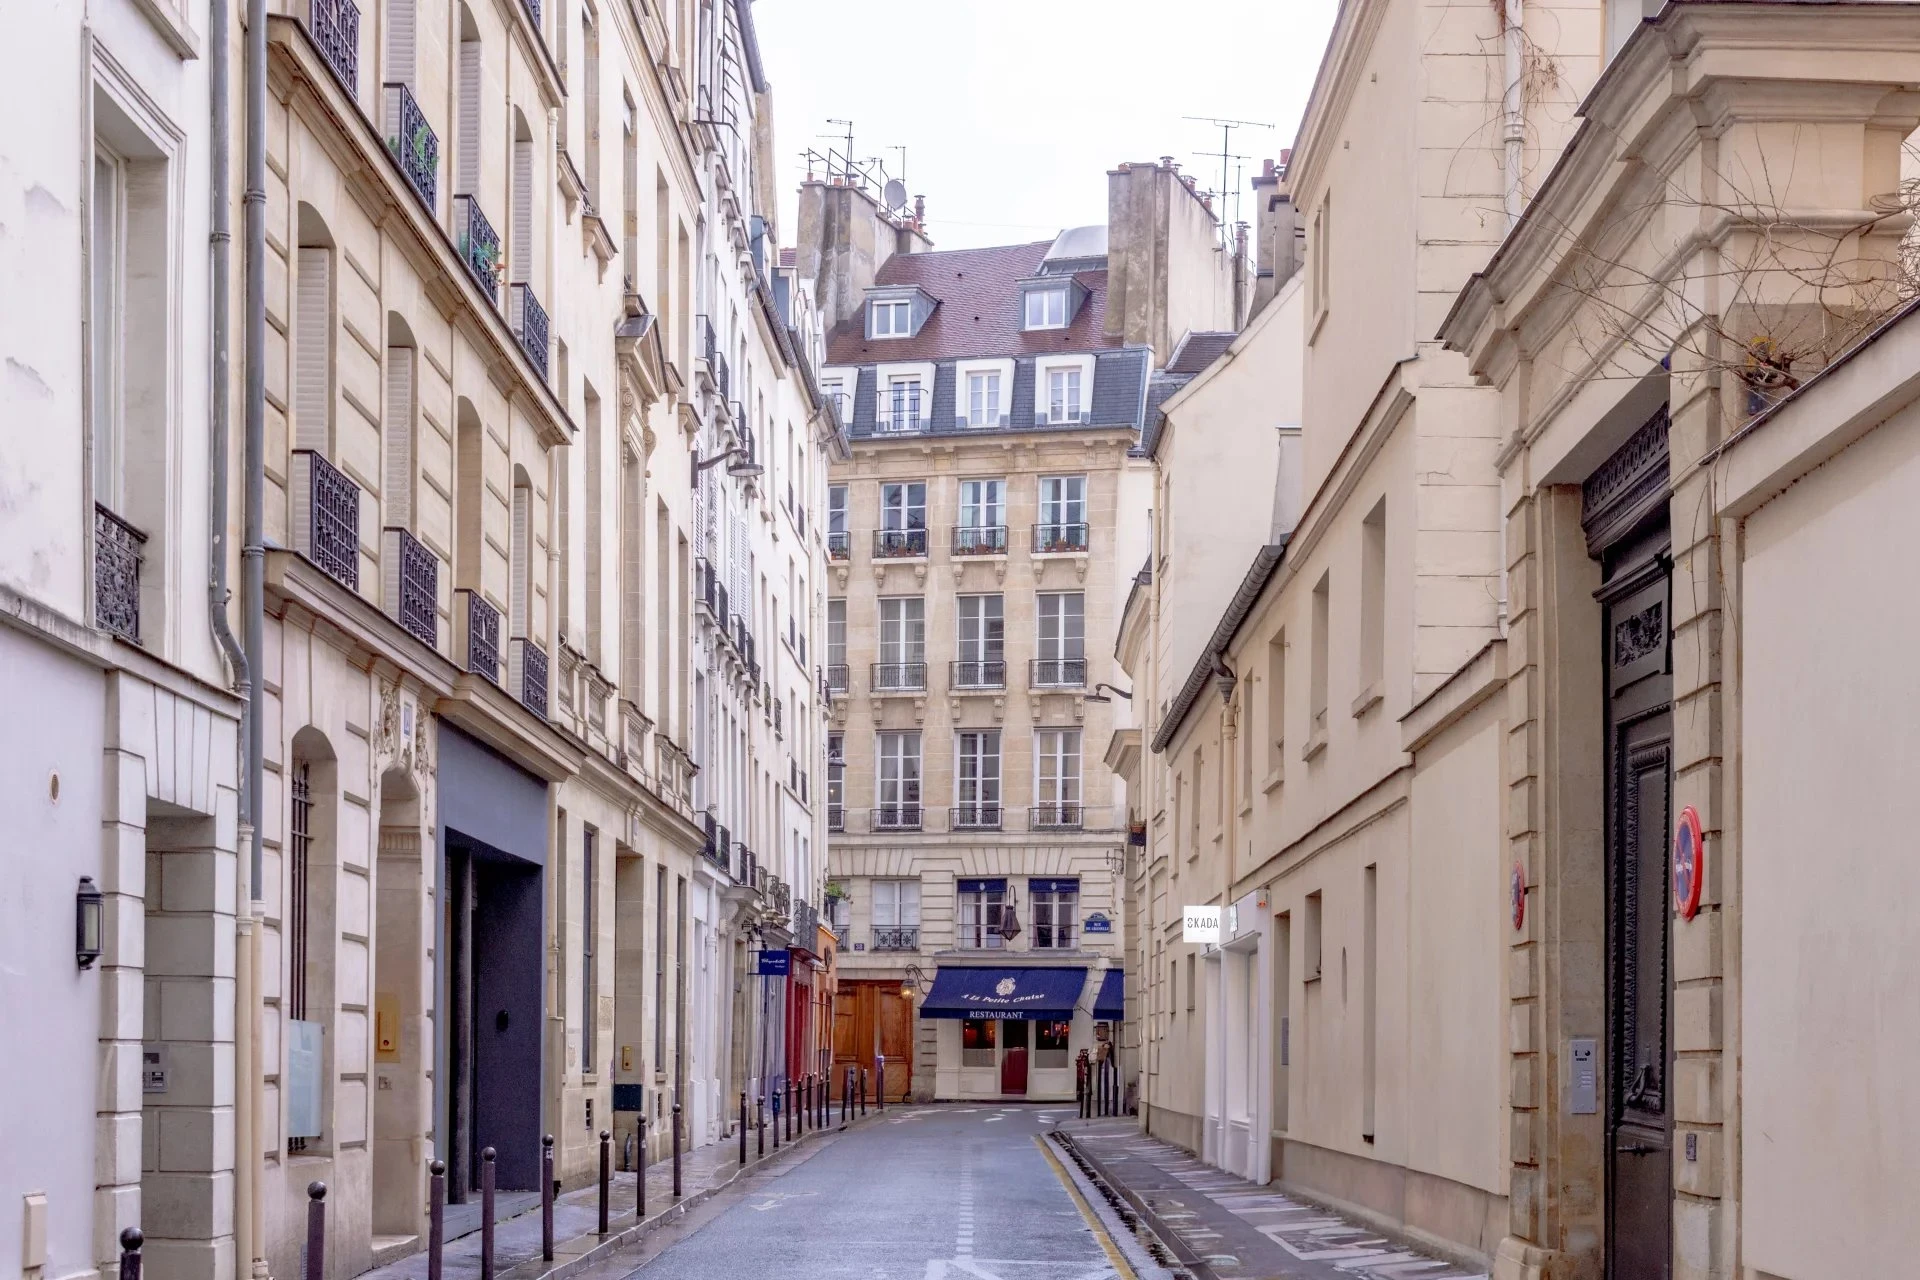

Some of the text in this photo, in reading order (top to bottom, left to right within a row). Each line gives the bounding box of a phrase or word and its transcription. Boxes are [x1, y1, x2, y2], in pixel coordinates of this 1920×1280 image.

[1187, 917, 1219, 929] OKADA
[982, 996, 1010, 1004] Petite
[1013, 993, 1045, 1003] Chaise
[969, 1010, 1024, 1019] RESTAURANT
